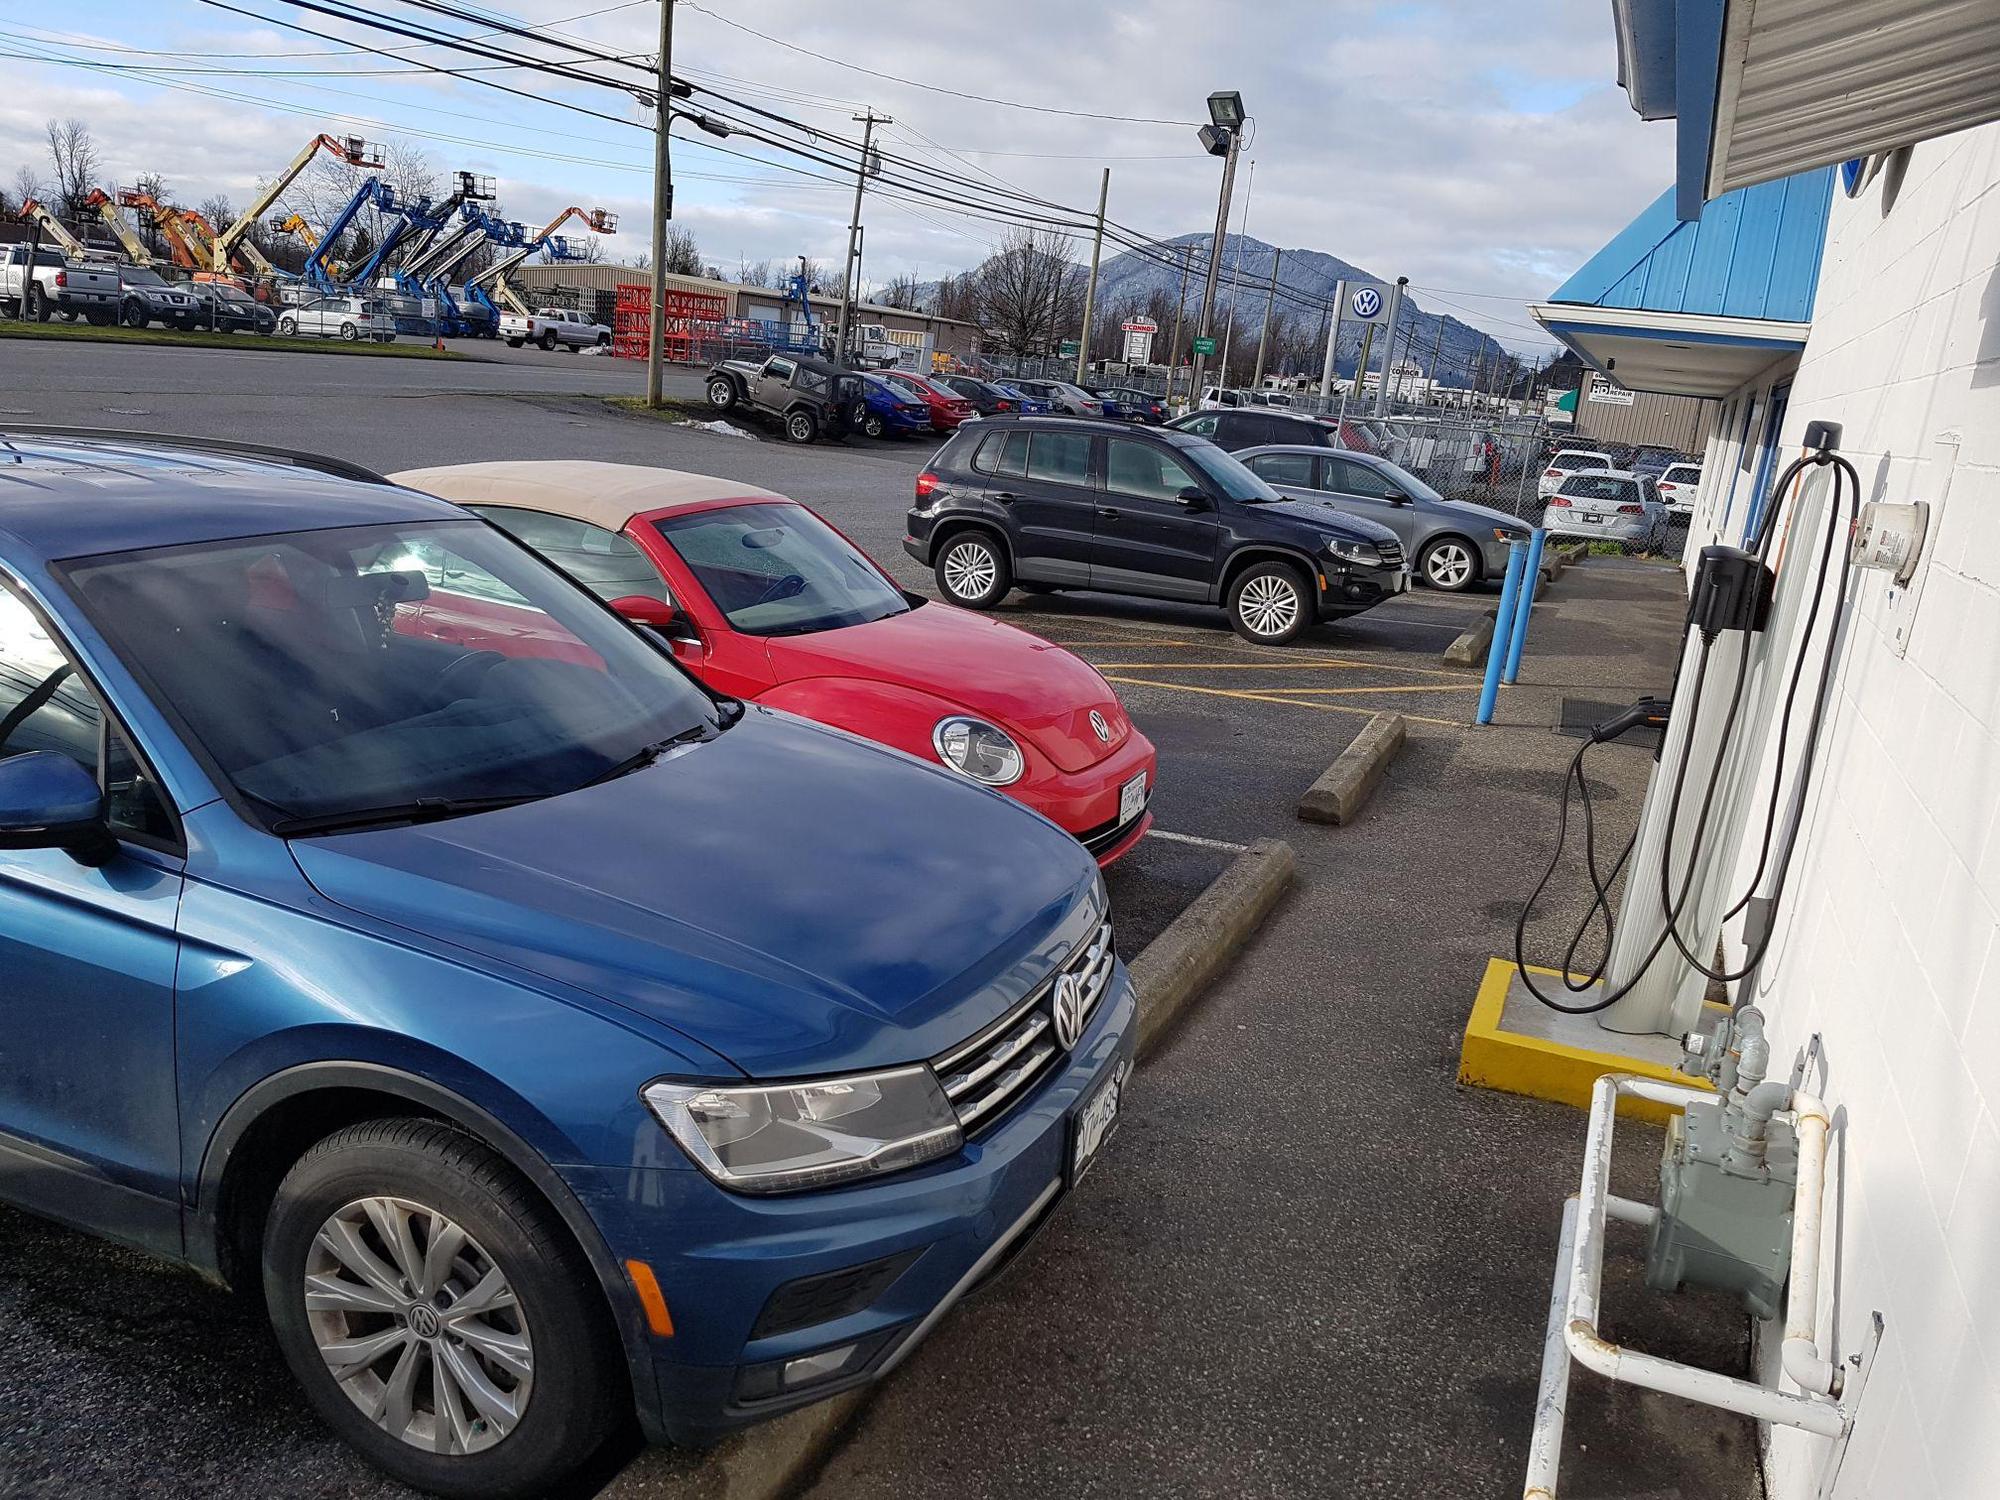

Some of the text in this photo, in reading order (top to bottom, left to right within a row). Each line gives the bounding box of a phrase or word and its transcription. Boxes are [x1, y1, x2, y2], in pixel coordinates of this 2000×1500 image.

[1353, 289, 1381, 316] VW
[1122, 324, 1156, 332] O'CONNOR
[1390, 368, 1419, 376] 'CONNOR
[1592, 385, 1609, 395] HD
